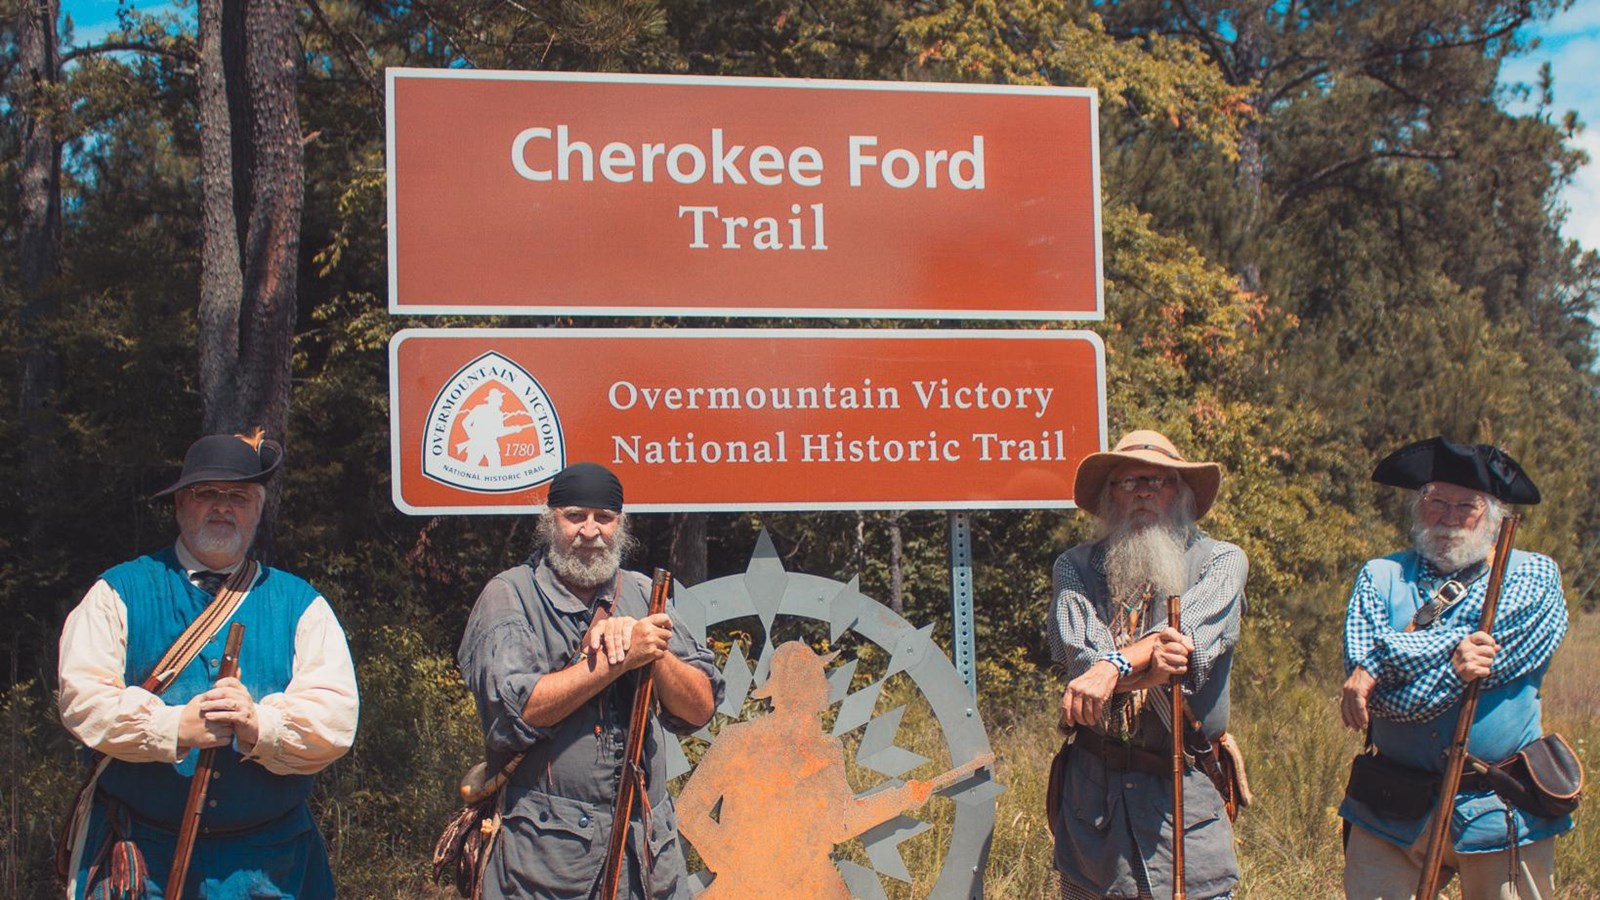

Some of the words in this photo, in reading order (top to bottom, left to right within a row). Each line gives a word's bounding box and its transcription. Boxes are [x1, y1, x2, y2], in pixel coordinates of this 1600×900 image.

[511, 124, 825, 188] Cherokee
[848, 134, 987, 191] Ford
[678, 202, 829, 251] Trail
[432, 366, 517, 456] OVERMOUNTAIN
[525, 385, 556, 457] VICTORY
[608, 378, 901, 411] Overmountain
[912, 378, 1054, 419] Victory
[504, 442, 535, 457] 1780
[611, 430, 788, 465] National
[800, 430, 961, 463] Historic
[972, 430, 1067, 462] Trail
[442, 463, 481, 481] NATIONAL
[484, 472, 521, 482] HISTORIC
[524, 465, 545, 477] TRAIL
